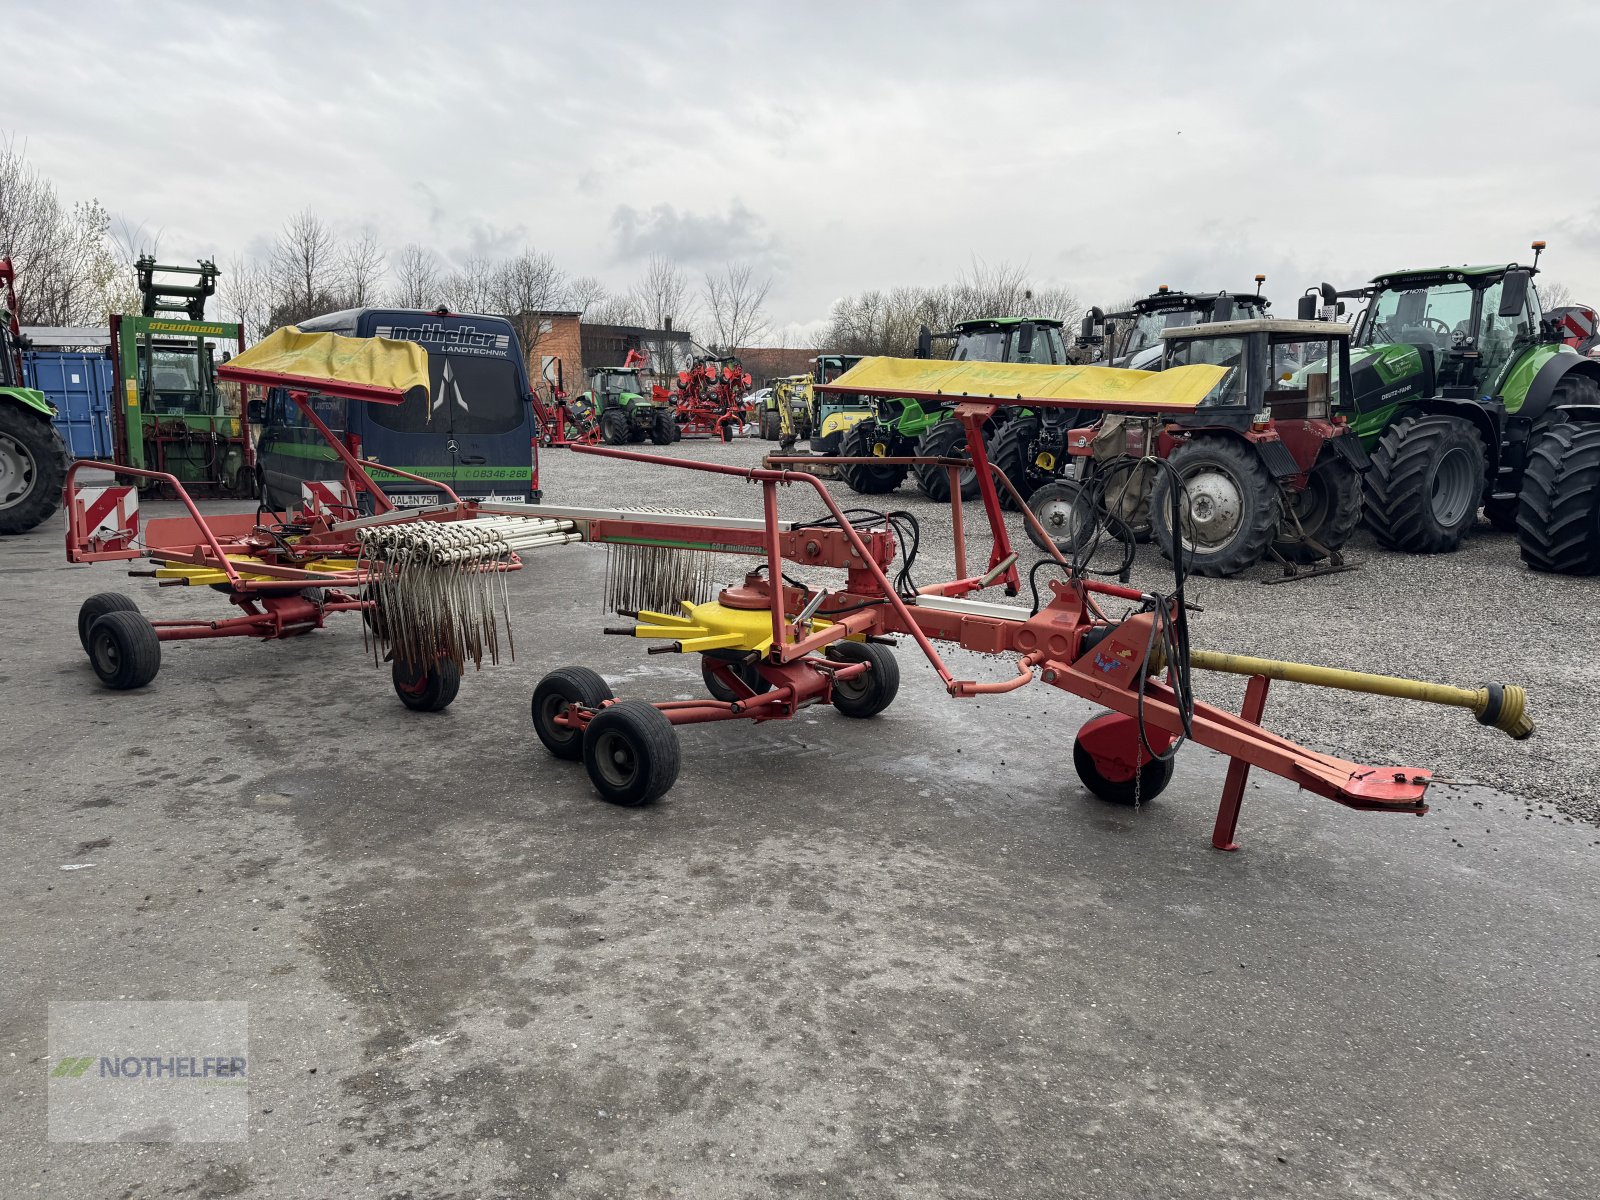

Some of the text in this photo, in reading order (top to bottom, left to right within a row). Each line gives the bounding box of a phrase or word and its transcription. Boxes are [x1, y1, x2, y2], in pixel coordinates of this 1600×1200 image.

[393, 323, 496, 346] nothelfer
[441, 346, 507, 357] LANDTECHNIK
[1381, 385, 1412, 400] DEUTZ-FAHR
[472, 470, 528, 479] 08346-268
[390, 496, 438, 504] OAL N 750
